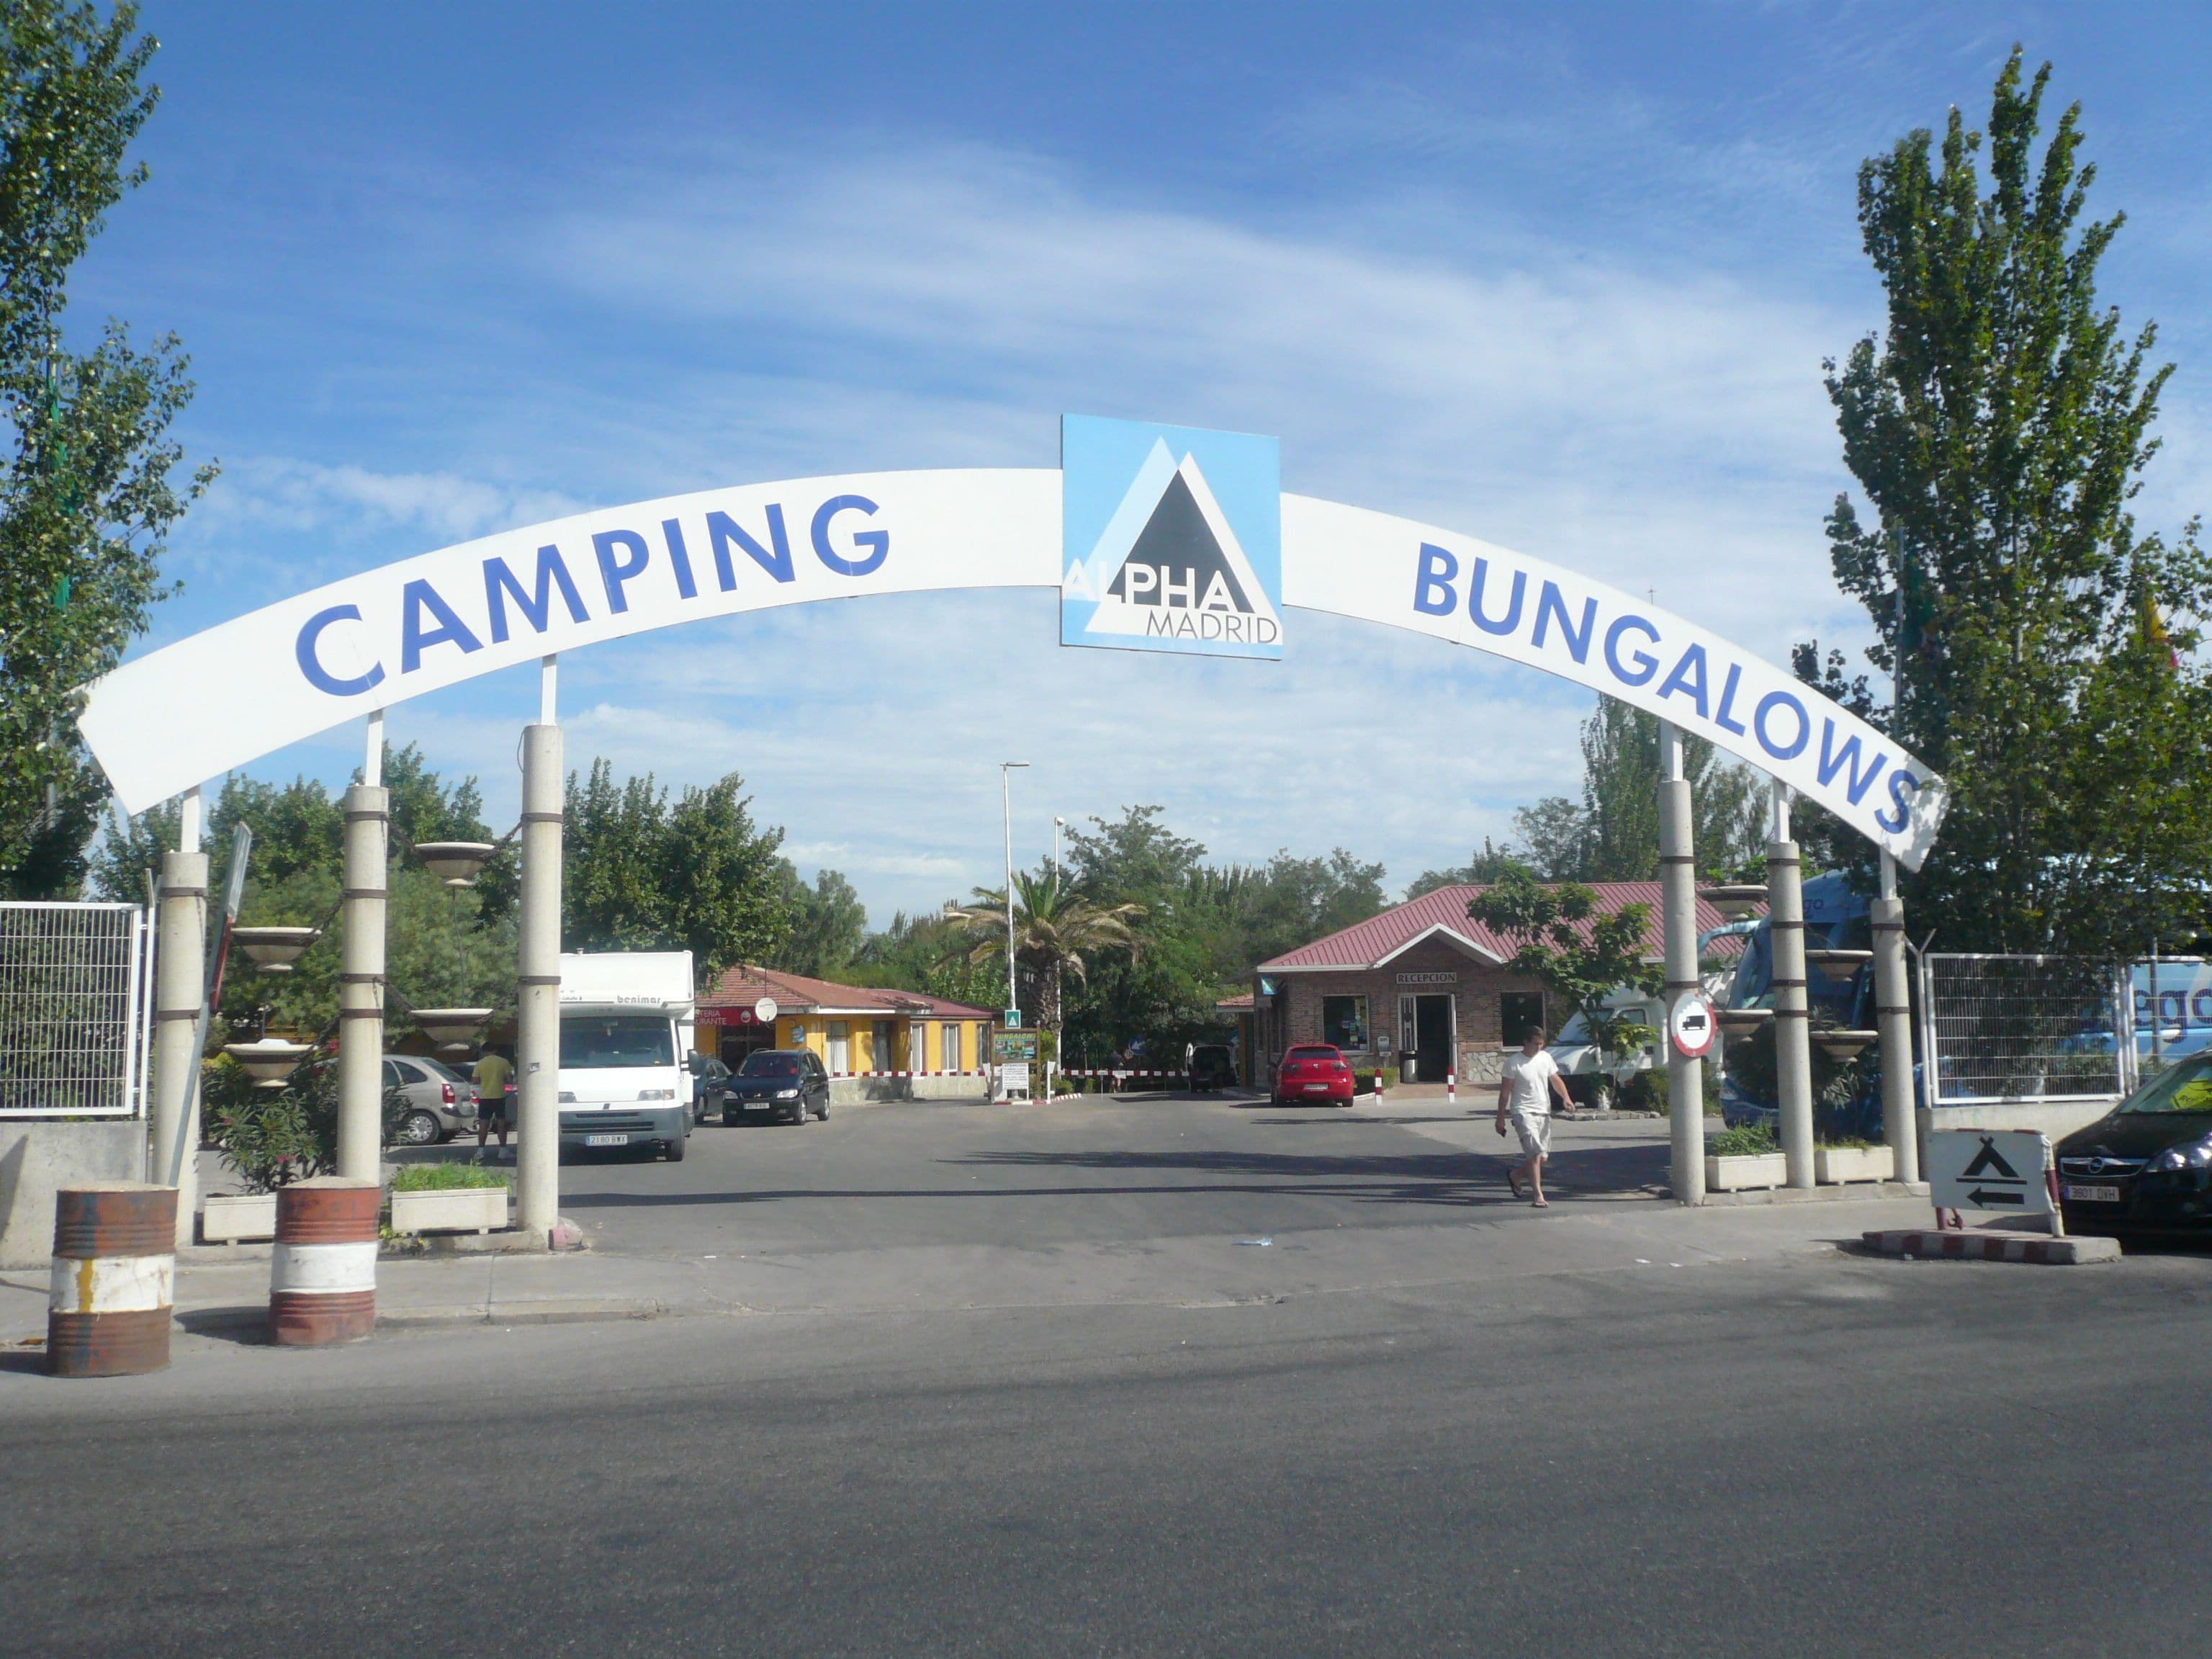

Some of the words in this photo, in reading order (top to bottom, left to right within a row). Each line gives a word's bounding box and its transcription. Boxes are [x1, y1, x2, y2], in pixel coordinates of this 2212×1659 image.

[295, 494, 890, 697] CAMPING
[1063, 558, 1239, 613] ALPHA
[1146, 609, 1279, 644] MADRID
[1412, 541, 1922, 835] BUNGALOWS
[617, 995, 661, 1004] benimar
[1398, 973, 1455, 983] RECEPCION
